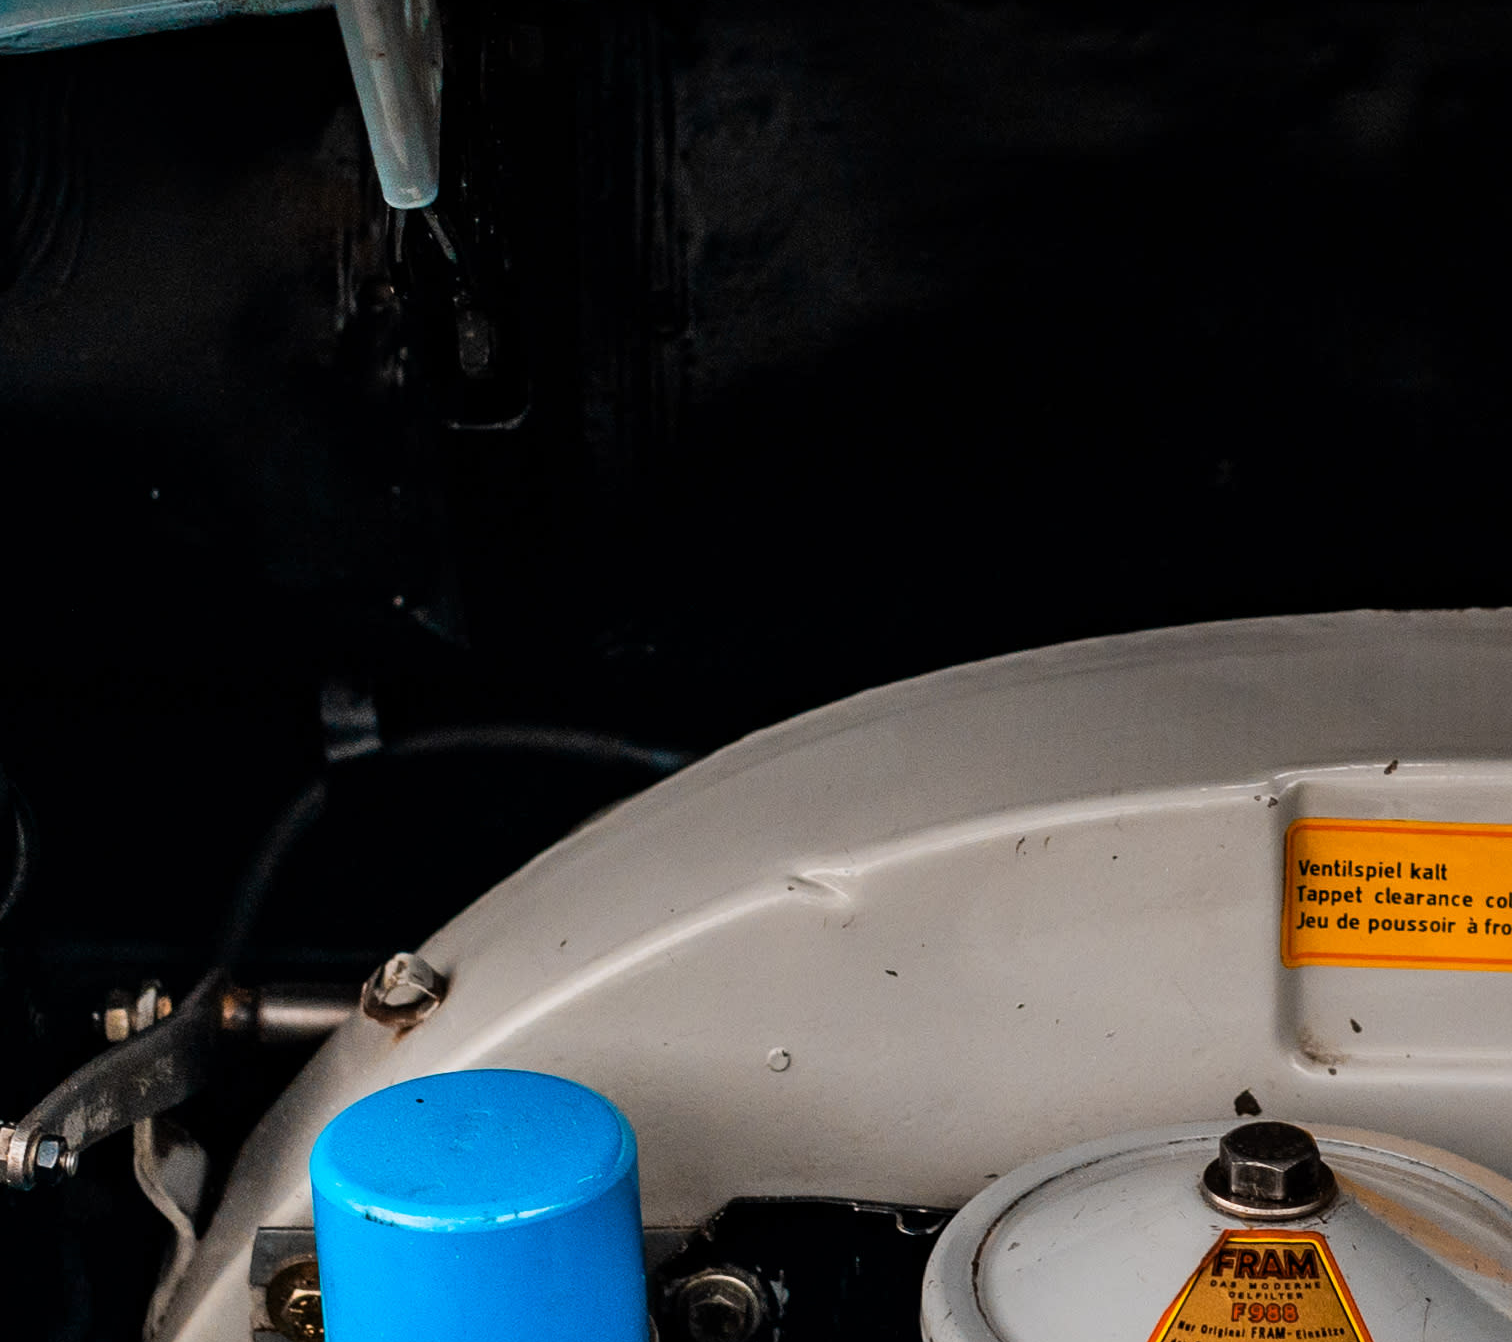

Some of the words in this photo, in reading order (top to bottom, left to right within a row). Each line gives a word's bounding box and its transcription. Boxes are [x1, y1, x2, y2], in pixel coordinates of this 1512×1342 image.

[1298, 859, 1402, 881] Ventilspiel
[1410, 861, 1448, 881] kalt
[1296, 885, 1362, 909] Tappet
[1373, 886, 1473, 908] clearance
[1296, 911, 1331, 930] Jeu
[1336, 913, 1360, 931] de
[1368, 914, 1457, 938] poussoir
[1466, 915, 1479, 935] à
[1210, 1248, 1321, 1280] FRAM
[1209, 1279, 1237, 1289] DAS
[1249, 1281, 1321, 1290] MODERNE
[1231, 1302, 1300, 1323] F988
[1177, 1320, 1196, 1332] Nur
[1200, 1324, 1245, 1339] Original
